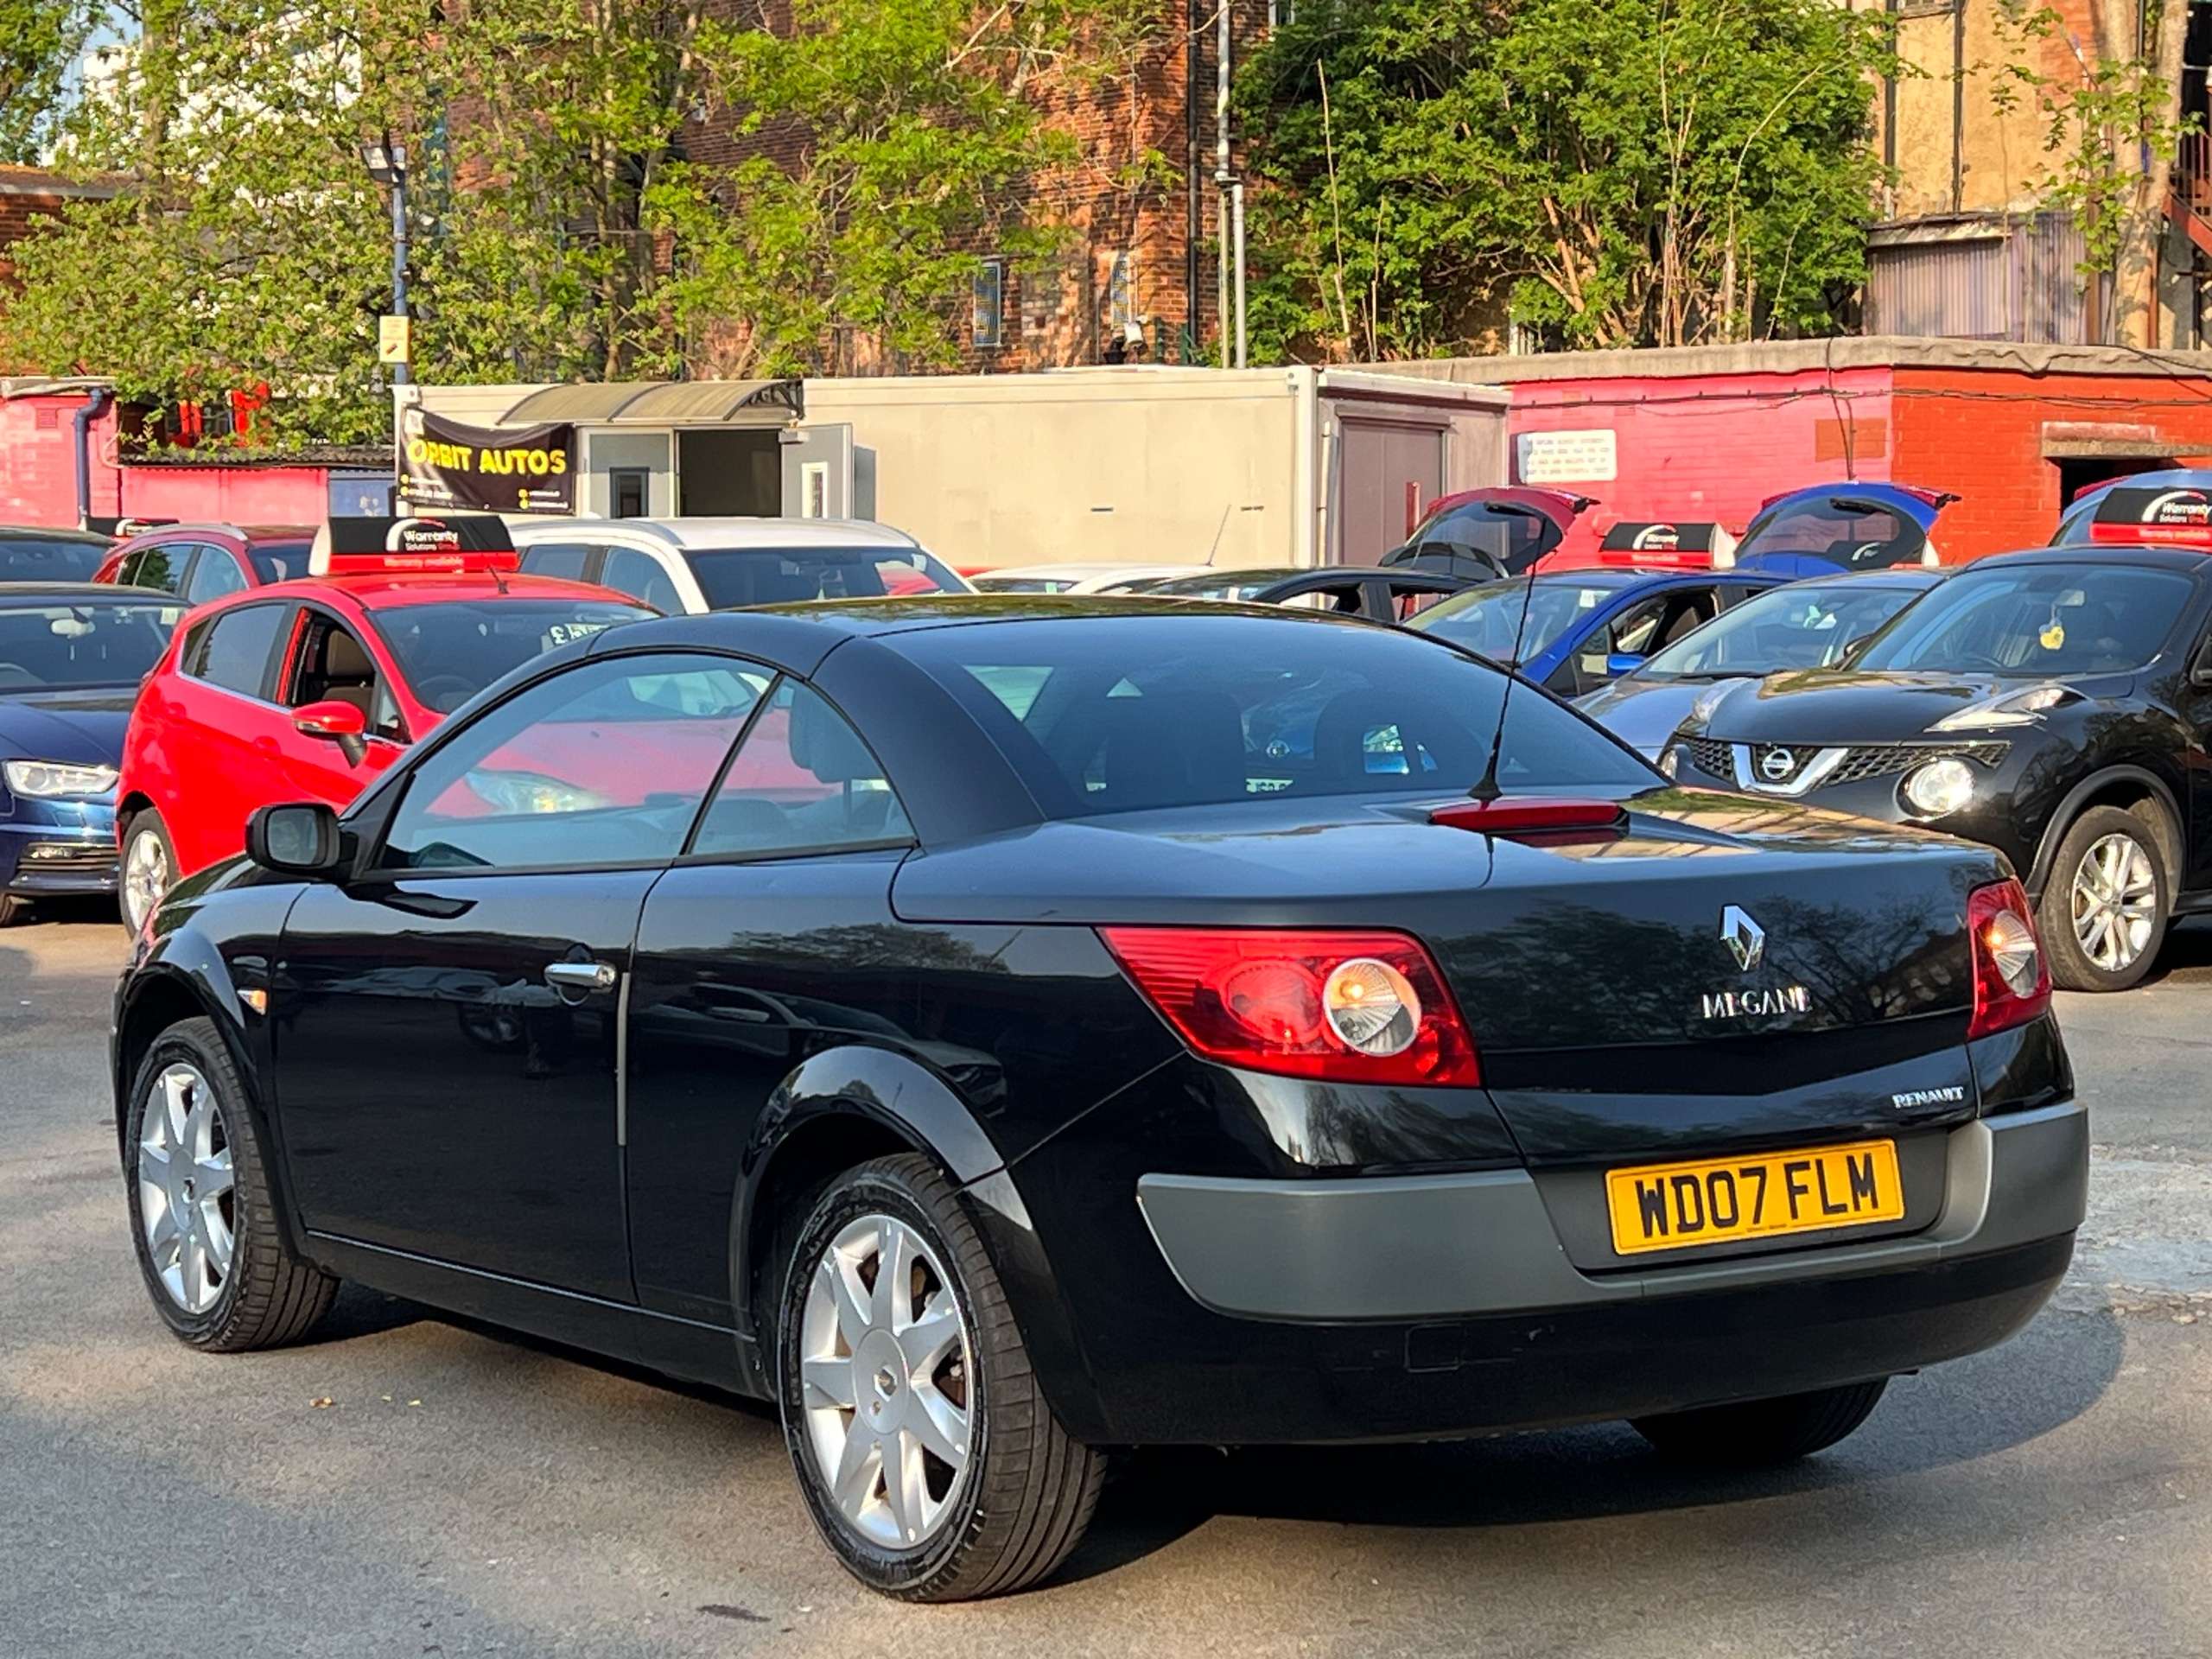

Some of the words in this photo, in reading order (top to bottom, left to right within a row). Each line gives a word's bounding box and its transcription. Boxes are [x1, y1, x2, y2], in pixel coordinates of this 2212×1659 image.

[407, 438, 473, 472] ORBIT
[479, 448, 567, 474] AUTOS
[403, 530, 459, 544] Warranty
[1702, 985, 1813, 1019] MEGANE
[1892, 1086, 1963, 1109] RENAULT
[1635, 1166, 1767, 1238] WD07
[1783, 1153, 1878, 1221] FLM
